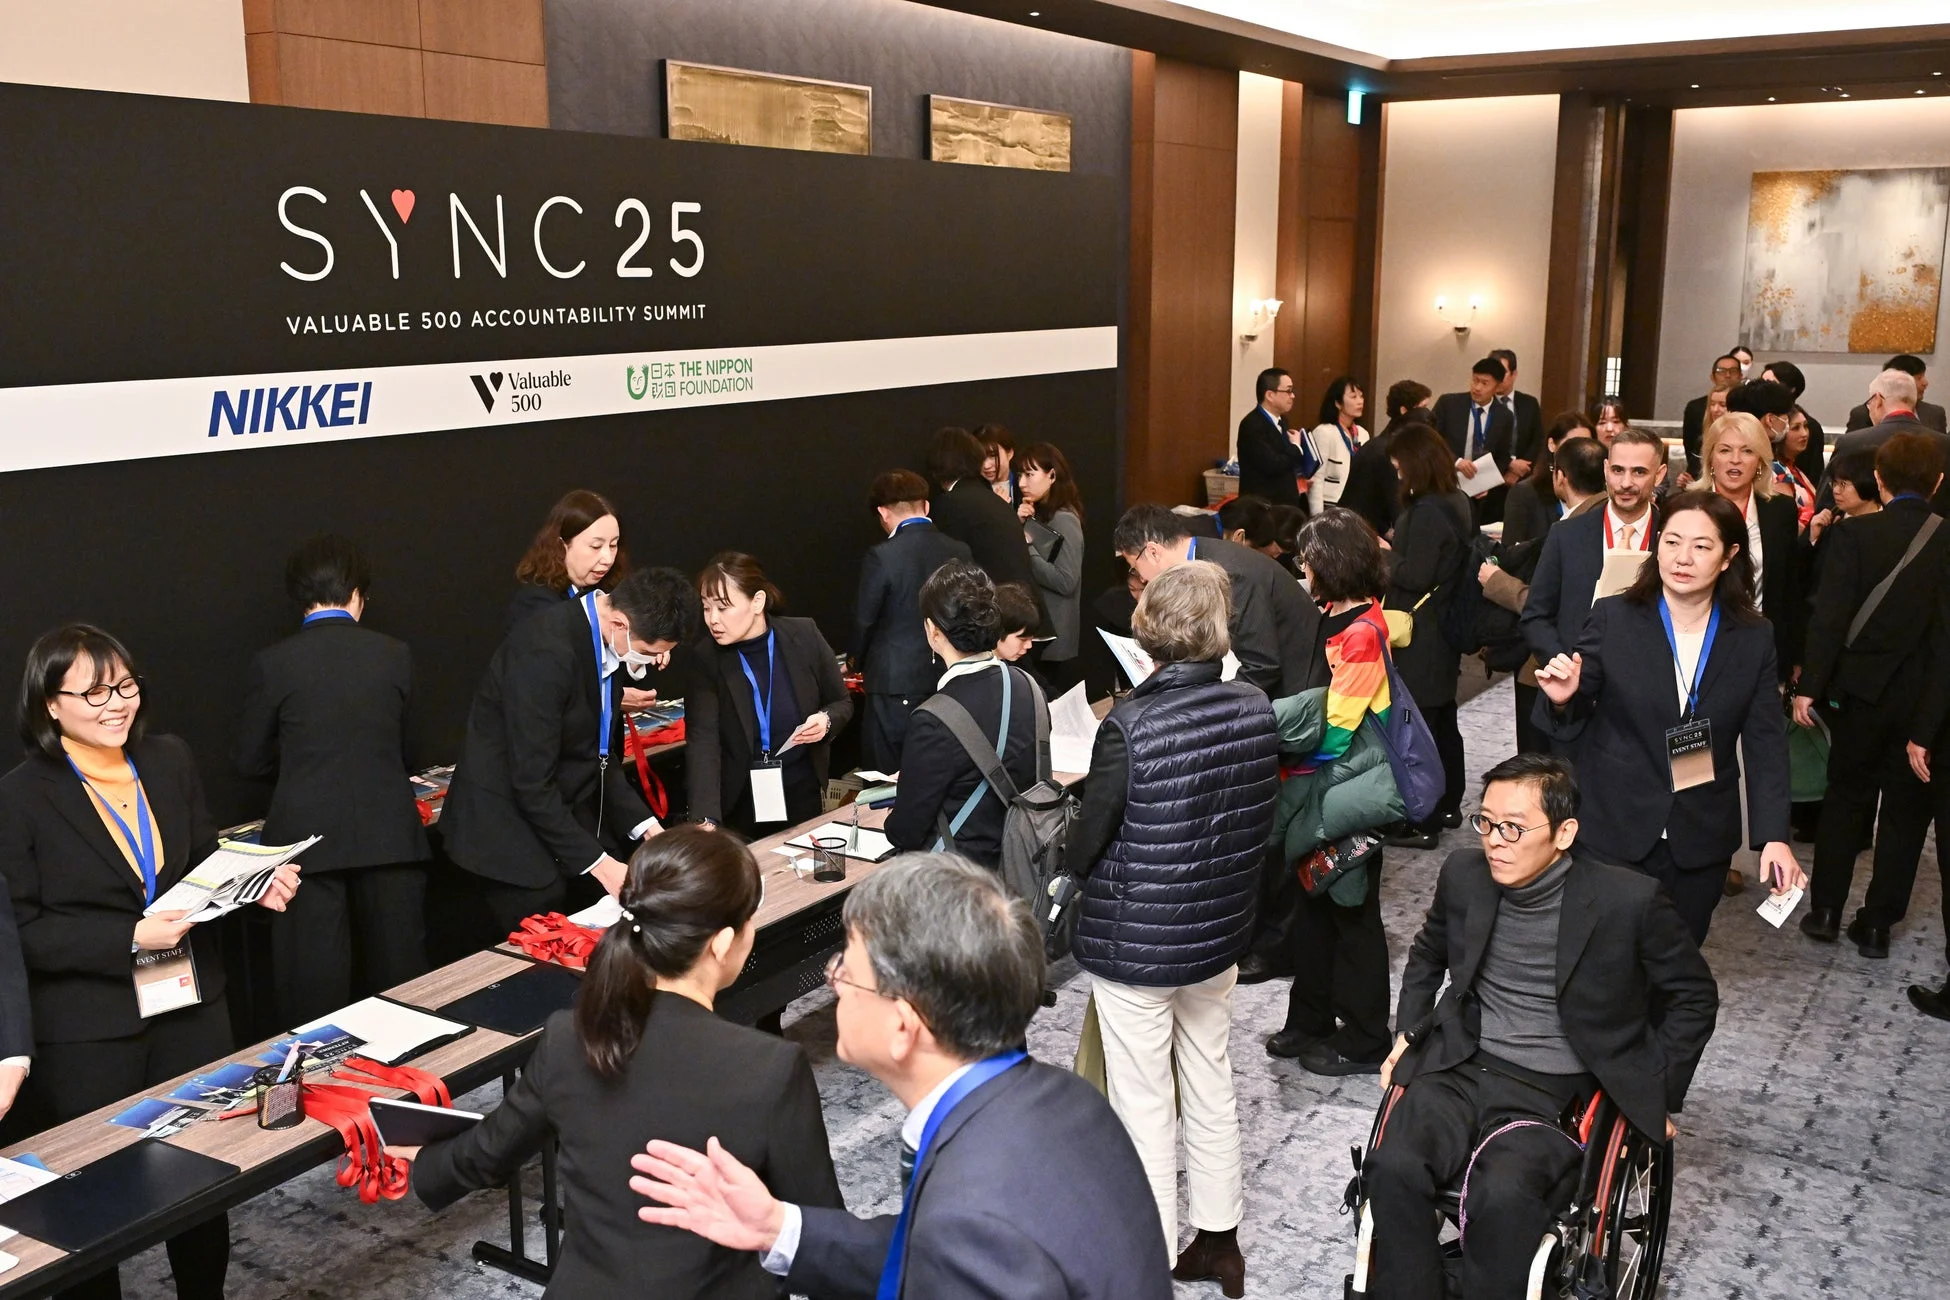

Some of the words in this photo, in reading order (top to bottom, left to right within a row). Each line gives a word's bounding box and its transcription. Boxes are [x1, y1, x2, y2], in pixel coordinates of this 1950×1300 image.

[286, 313, 410, 334] VALUABLE
[422, 311, 461, 329] 500
[472, 306, 635, 327] ACCOUNTABILITY
[644, 305, 705, 320] SUMMIT
[680, 361, 701, 376] THE
[707, 359, 752, 375] NIPPON
[509, 370, 571, 390] Valuable
[681, 378, 752, 395] FOUNDATION
[208, 382, 373, 437] NIKKEI
[512, 394, 541, 412] 500
[1672, 745, 1689, 754] EVENT
[1690, 741, 1706, 750] STAFF
[136, 953, 160, 965] EVENT
[161, 947, 183, 959] STAFF
